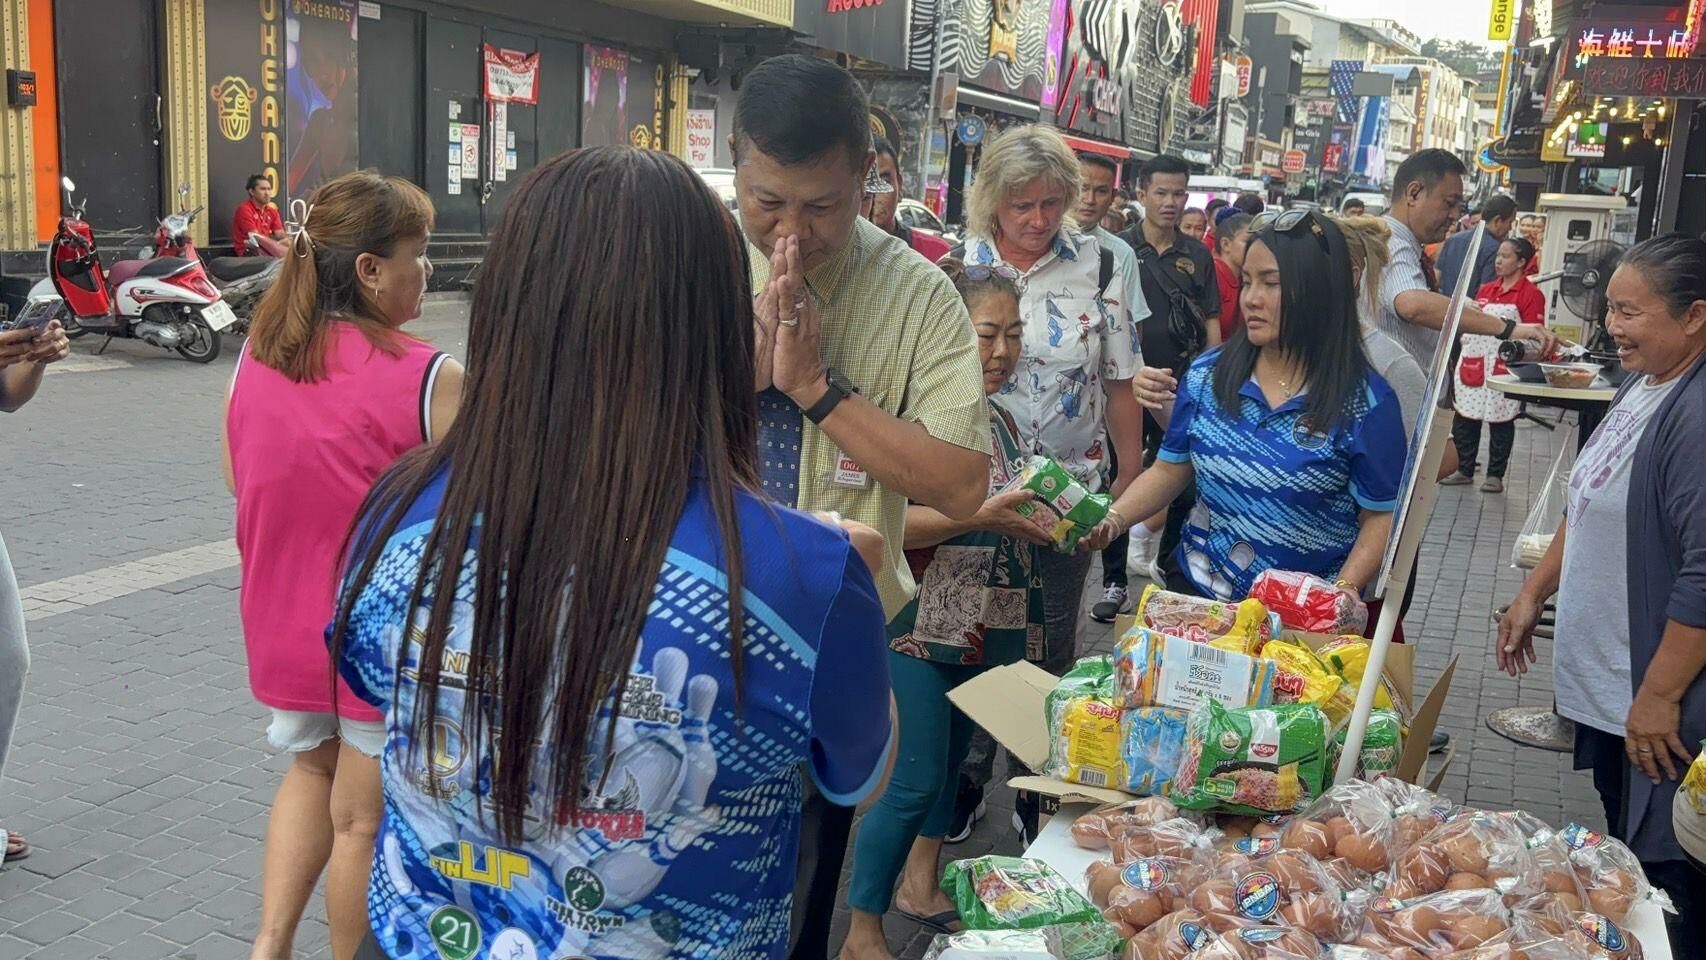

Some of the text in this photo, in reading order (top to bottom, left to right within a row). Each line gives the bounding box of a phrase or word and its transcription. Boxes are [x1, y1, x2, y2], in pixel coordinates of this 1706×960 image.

[1494, 0, 1508, 33] nge
[259, 0, 280, 213] OKEANO
[688, 133, 711, 149] Shop
[692, 150, 707, 161] For
[440, 915, 471, 949] 21
